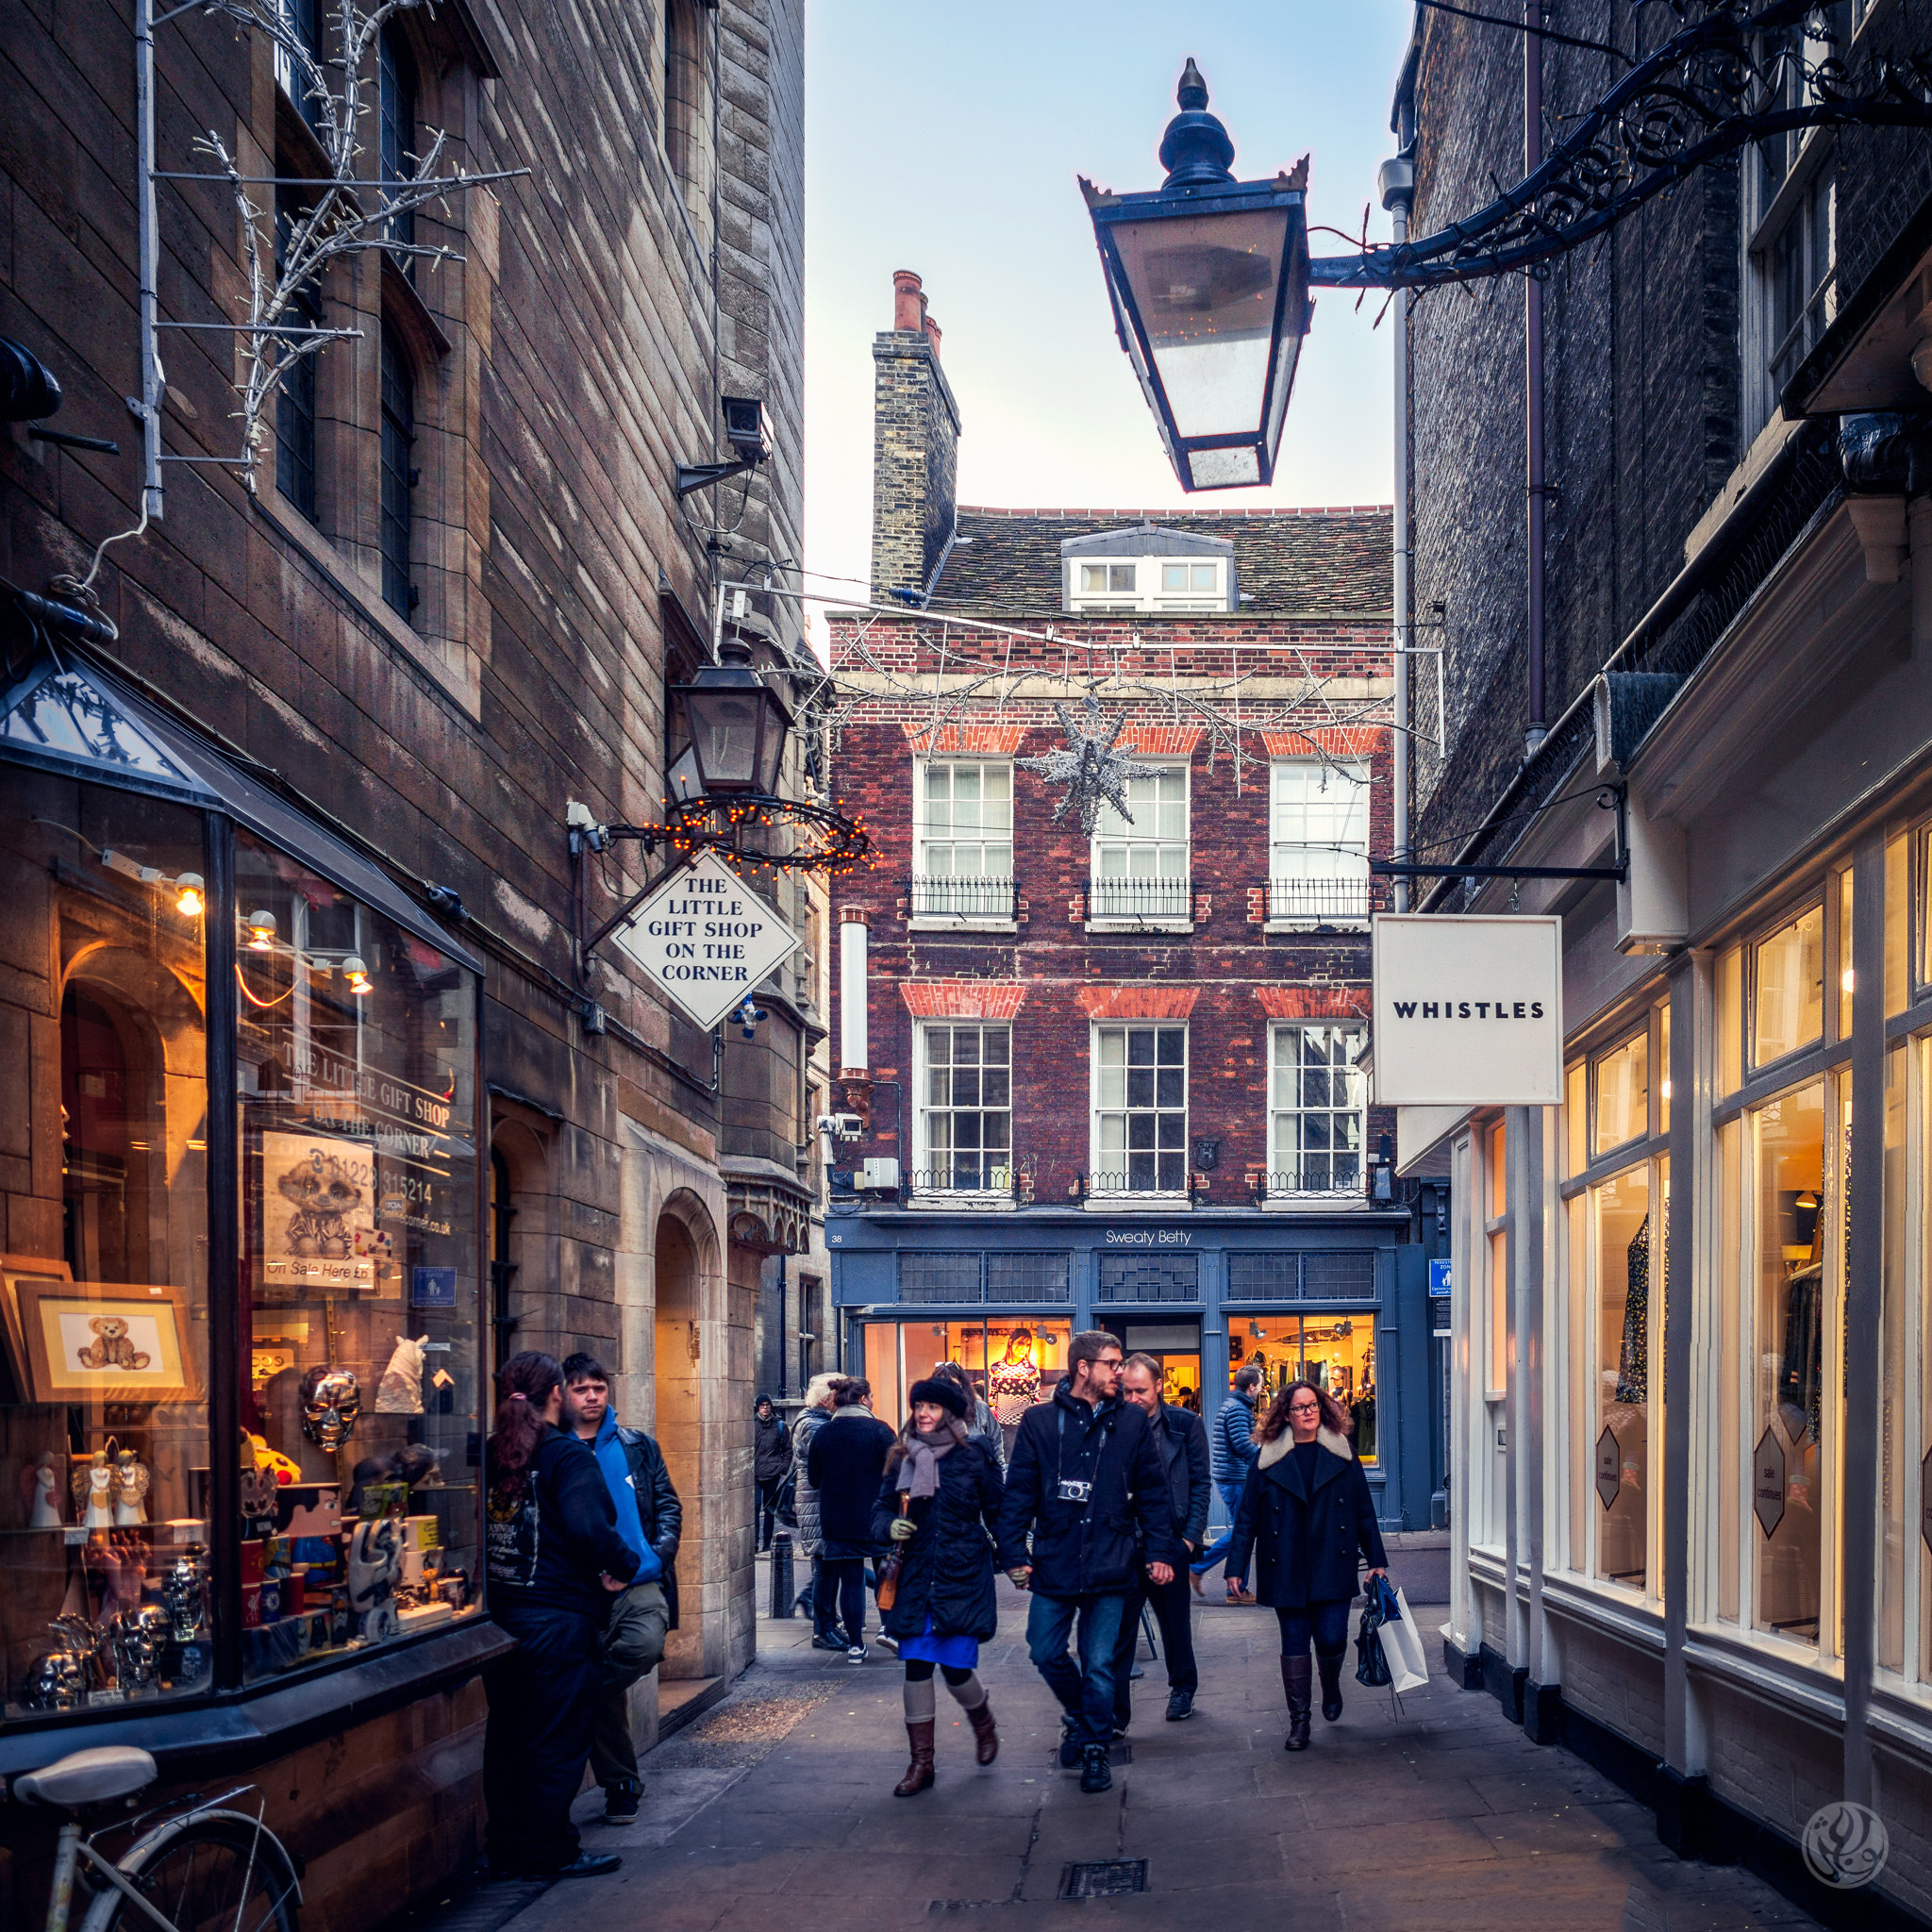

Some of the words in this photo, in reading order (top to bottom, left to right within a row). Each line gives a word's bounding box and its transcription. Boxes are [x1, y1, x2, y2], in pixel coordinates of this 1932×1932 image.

[684, 878, 726, 893] THE
[668, 899, 743, 916] LITTLE
[648, 921, 696, 936] GIFT
[704, 922, 763, 938] SHOP
[665, 942, 695, 958] ON
[703, 944, 745, 959] THE
[662, 965, 748, 981] CORNER
[1392, 1002, 1544, 1019] WHISTLES
[283, 1041, 318, 1077] THE
[323, 1058, 376, 1101] LITTLE
[380, 1082, 412, 1114] GIFT
[415, 1097, 451, 1128] SHOP
[312, 1098, 335, 1125] ON
[341, 1108, 371, 1138] THE
[375, 1121, 430, 1159] CORNER
[331, 1155, 377, 1191] 01223
[382, 1171, 433, 1206] 315214
[831, 1235, 842, 1243] 38
[1106, 1229, 1155, 1246] Sweaty
[1158, 1229, 1191, 1246] Betty
[267, 1260, 286, 1274] On
[290, 1261, 319, 1275] Sale
[322, 1264, 351, 1278] Here
[1603, 1455, 1612, 1465] sale
[1763, 1465, 1774, 1478] sale
[1757, 1487, 1782, 1501] continues
